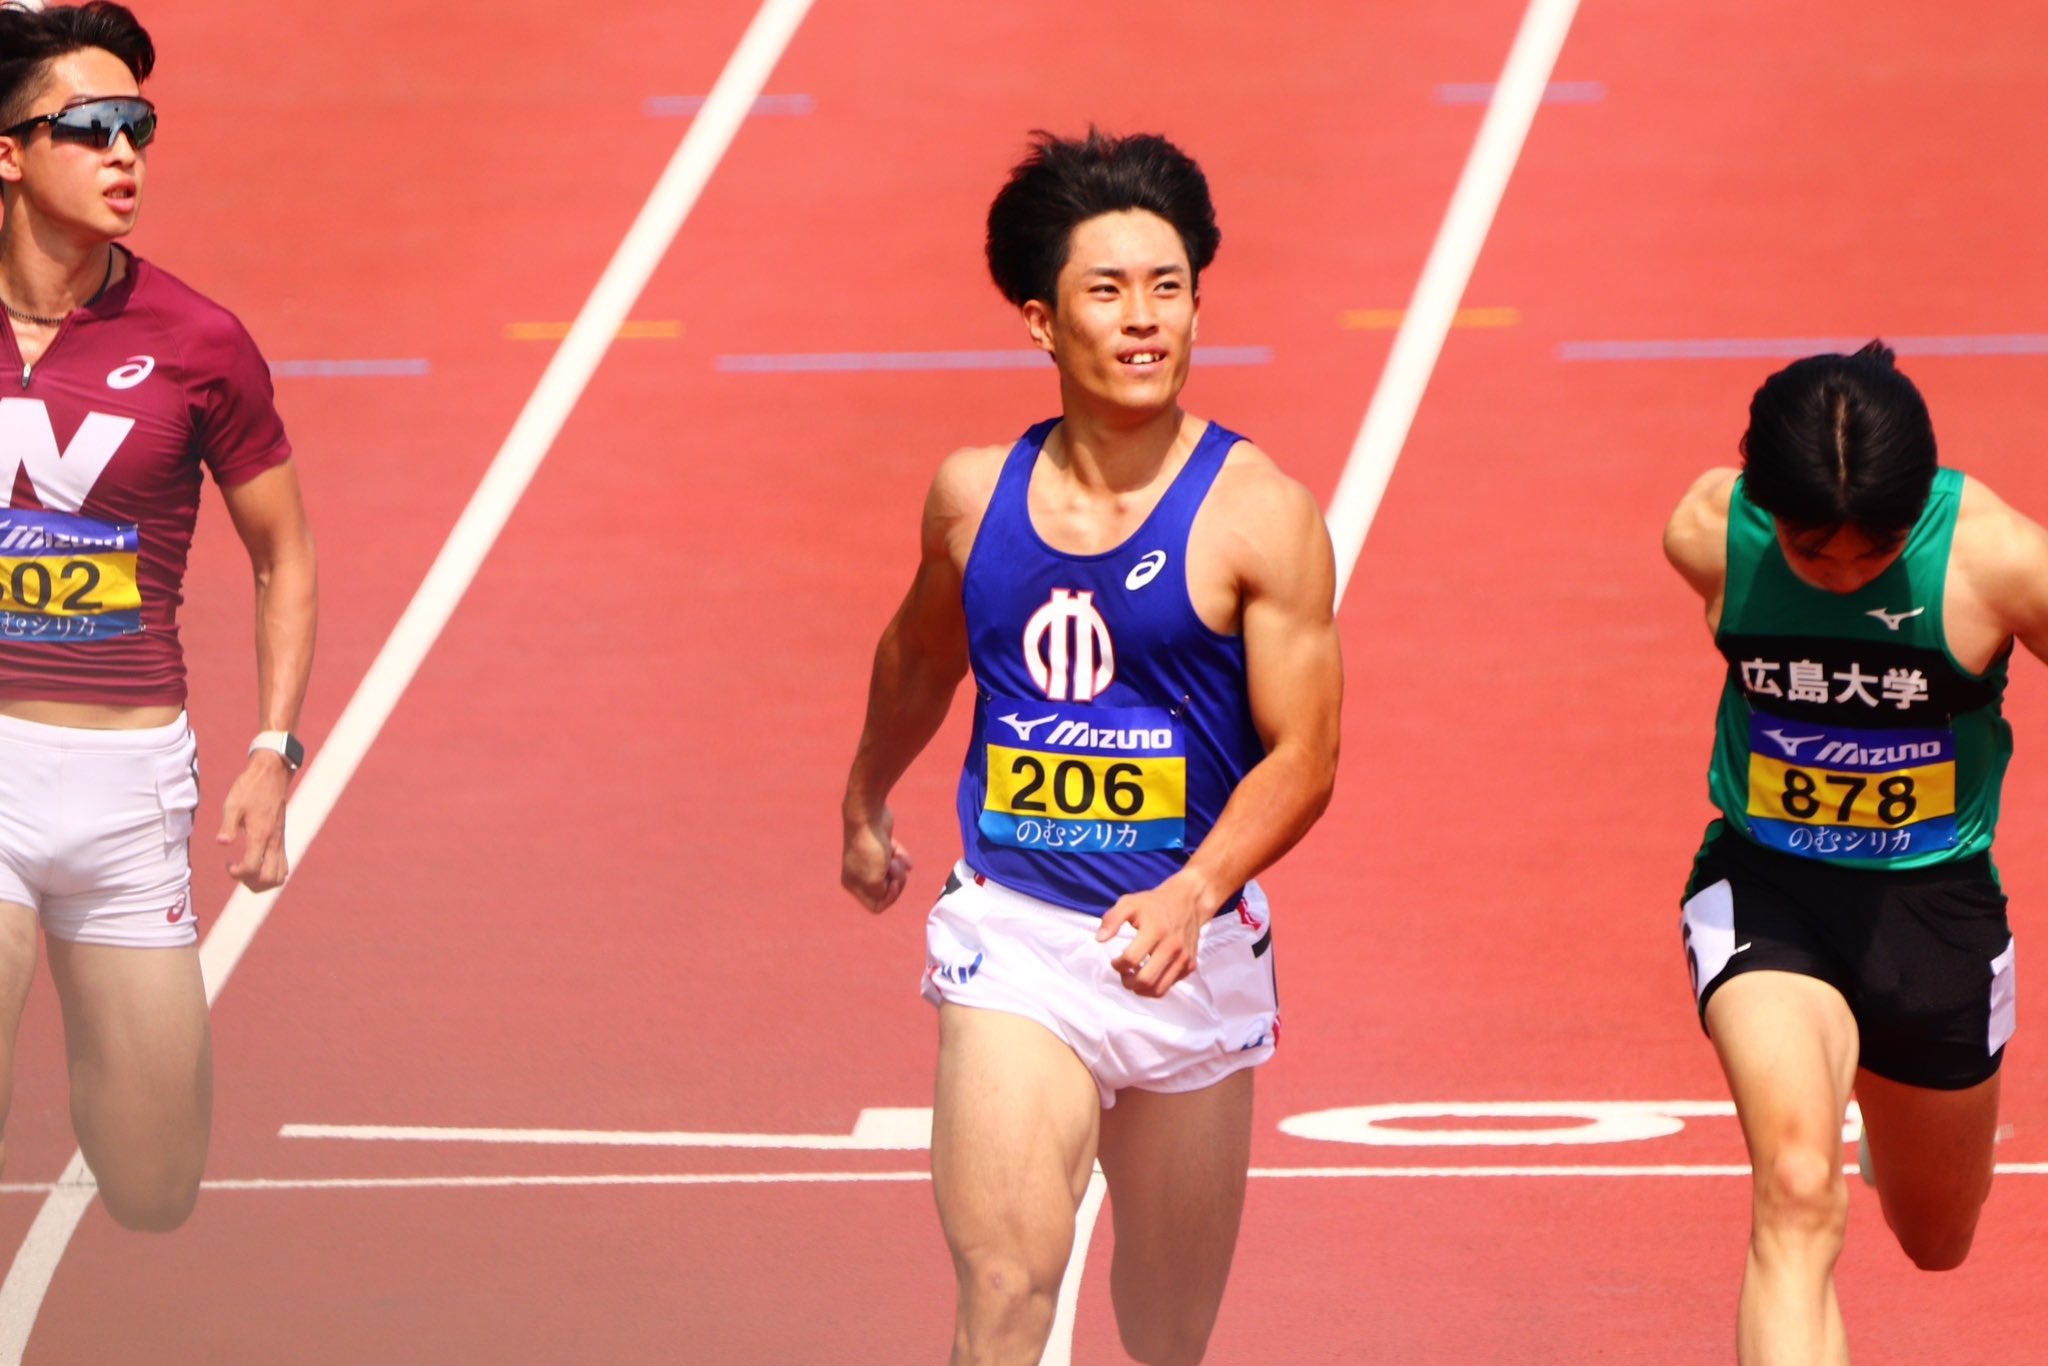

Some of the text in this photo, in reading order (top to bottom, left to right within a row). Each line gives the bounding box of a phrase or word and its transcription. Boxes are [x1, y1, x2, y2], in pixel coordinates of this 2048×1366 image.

[0, 561, 103, 611] 02
[1740, 657, 1929, 710] 広島大学
[1010, 755, 1145, 816] 206
[1781, 768, 1917, 825] 878
[1016, 819, 1138, 848] のむシリカ
[1788, 826, 1911, 855] のむシリカ
